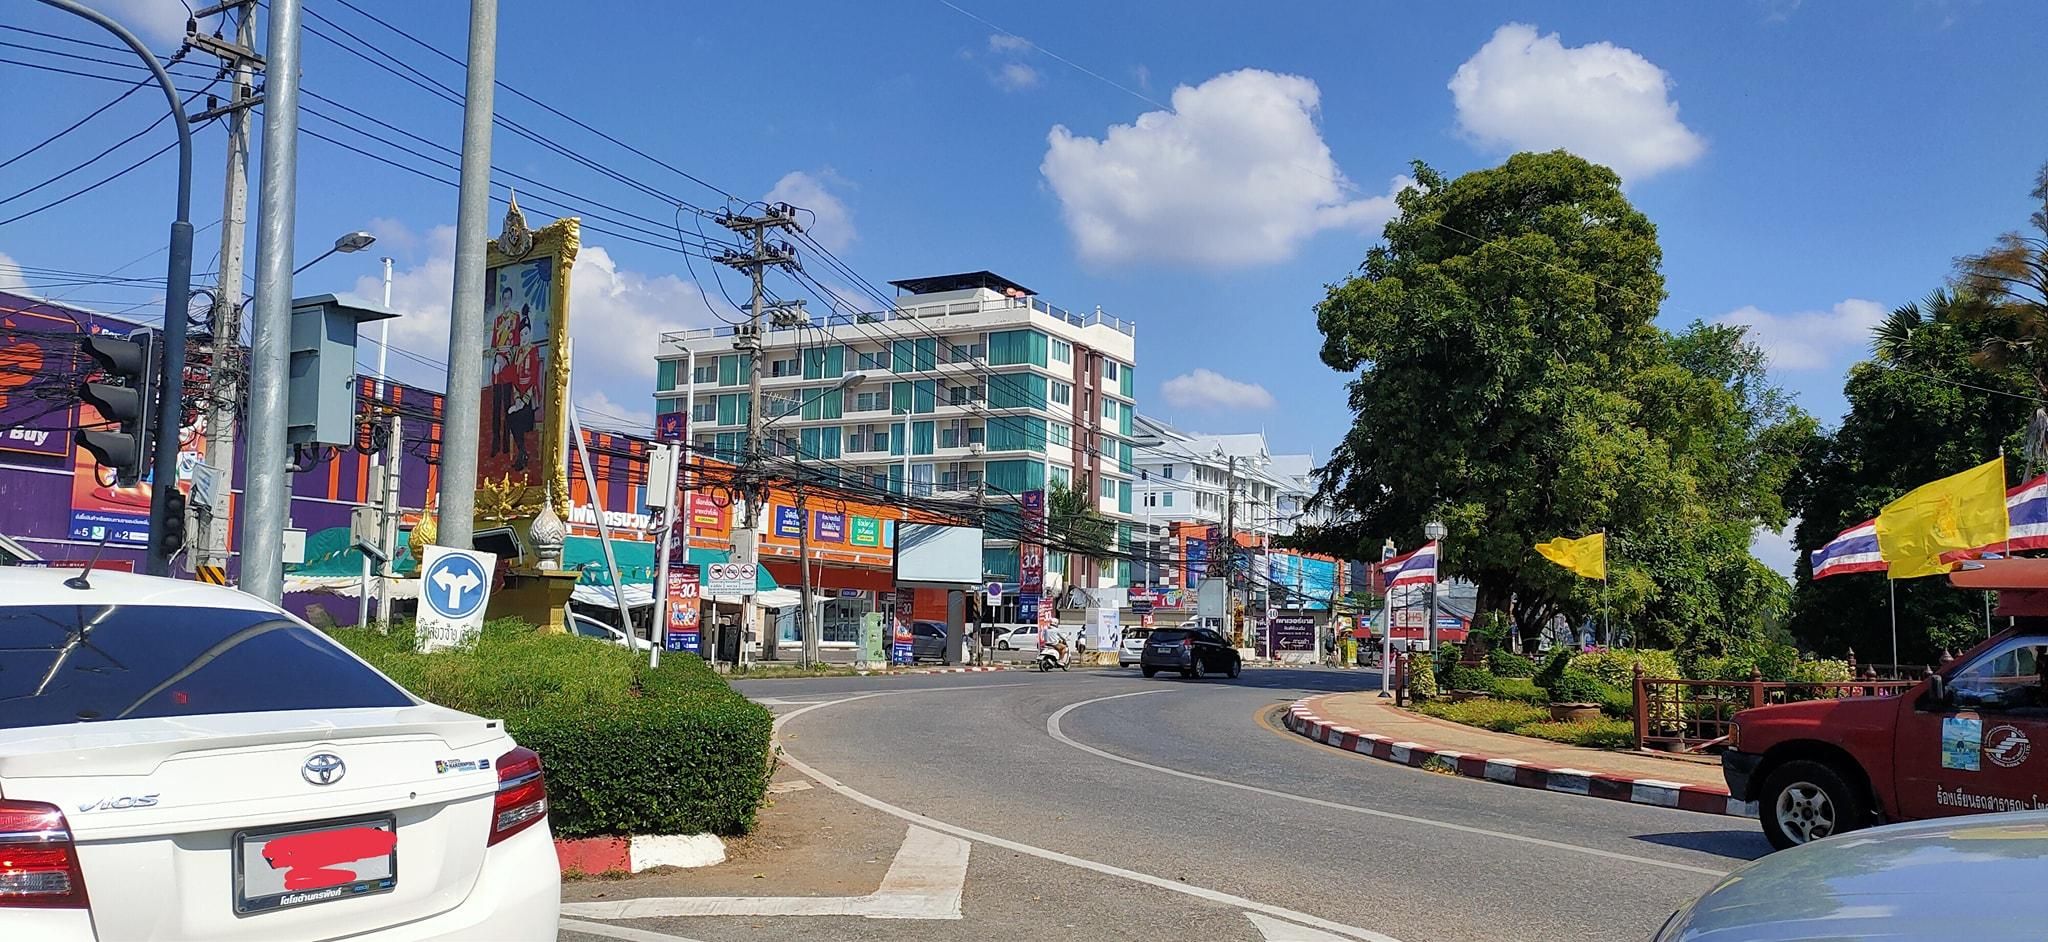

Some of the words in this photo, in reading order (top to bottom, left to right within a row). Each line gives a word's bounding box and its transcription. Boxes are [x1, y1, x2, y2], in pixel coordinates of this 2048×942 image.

[9, 425, 48, 446] Buy
[81, 527, 89, 537] 5
[121, 530, 129, 540] 2
